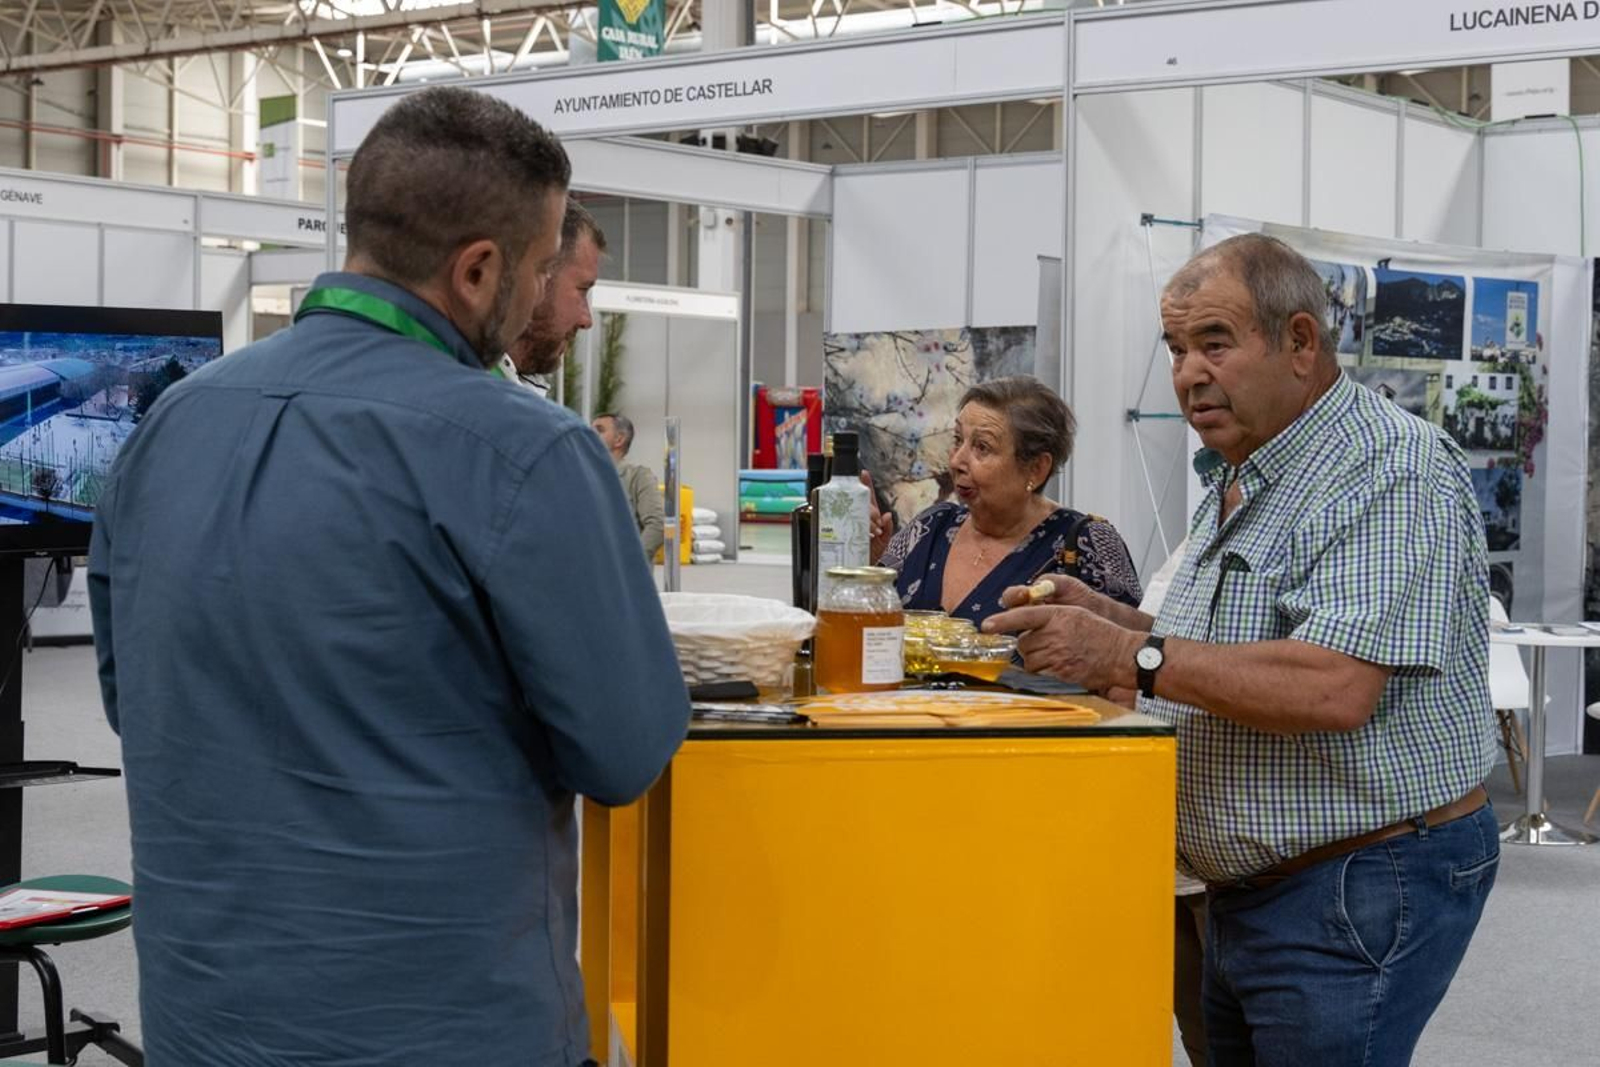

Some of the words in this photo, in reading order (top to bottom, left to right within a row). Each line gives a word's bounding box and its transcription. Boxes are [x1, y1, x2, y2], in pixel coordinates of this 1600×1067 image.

[1450, 3, 1577, 31] LUCAINENA
[554, 89, 661, 115] AYUNTAMIENTO
[664, 88, 683, 104] DE
[686, 79, 773, 102] CASTELLAR
[298, 217, 346, 235] PARE
